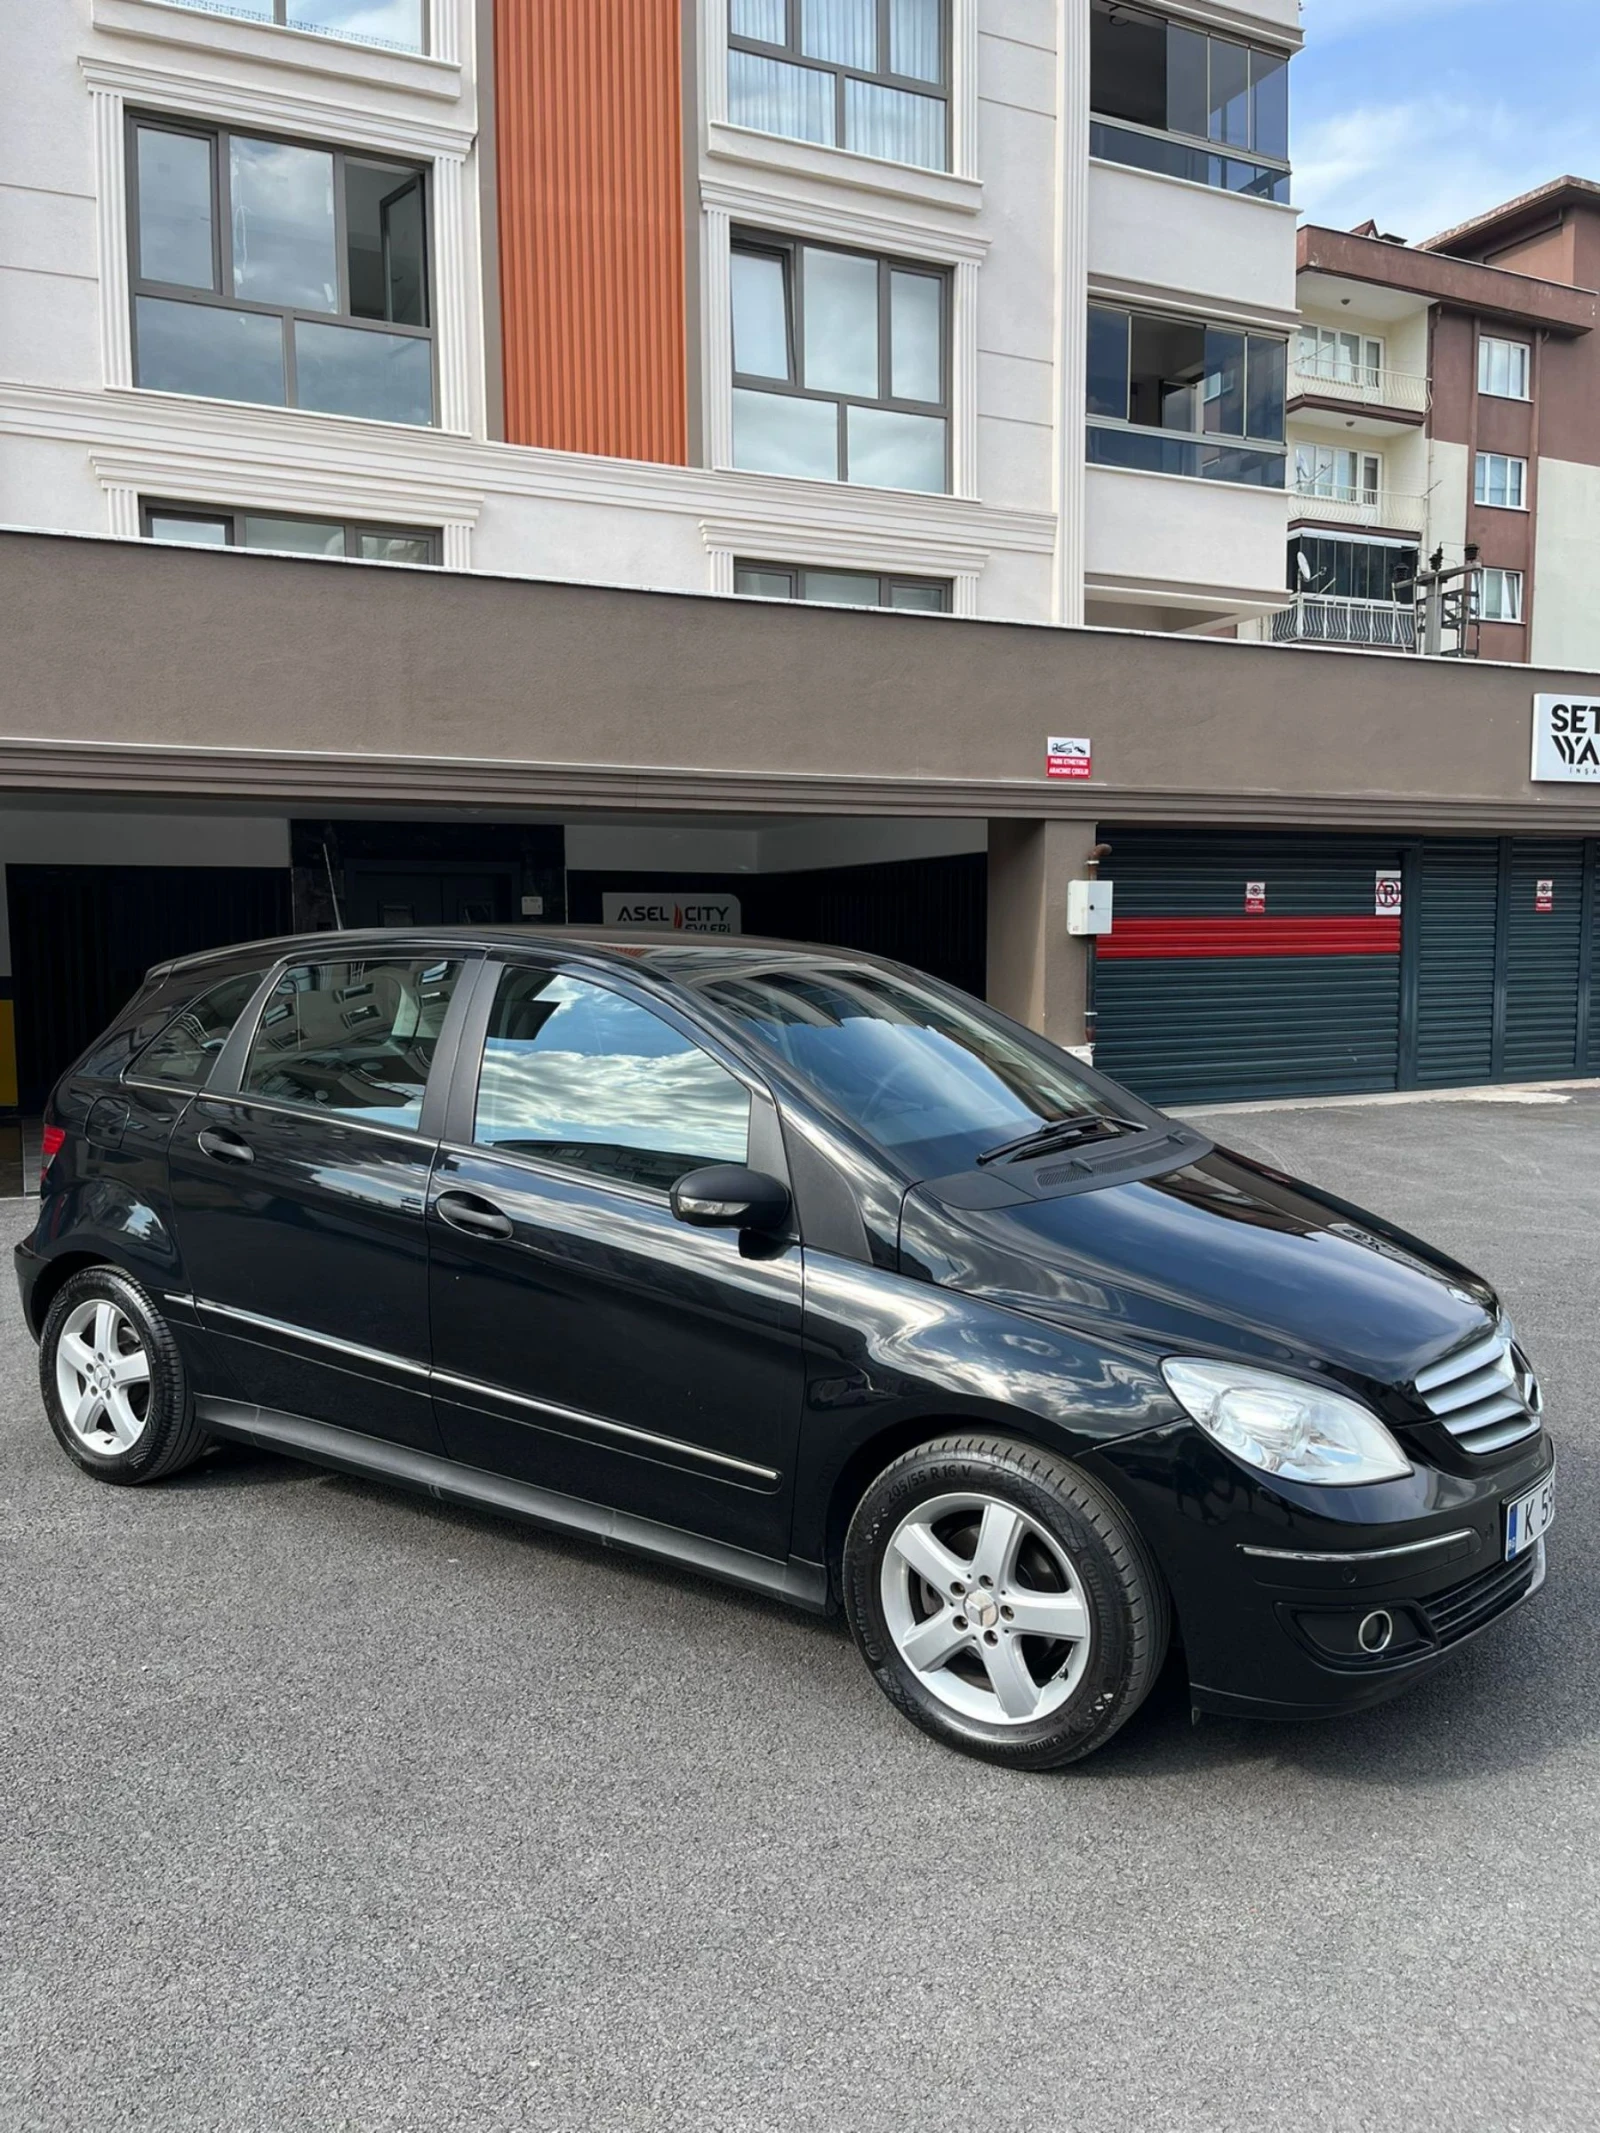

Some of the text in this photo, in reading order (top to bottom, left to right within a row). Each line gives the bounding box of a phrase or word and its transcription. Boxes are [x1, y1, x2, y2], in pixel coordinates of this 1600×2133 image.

[617, 906, 729, 921] ASEL CITY
[887, 1469, 927, 1503] 205/55
[961, 1465, 972, 1477] V
[1525, 1499, 1535, 1540] K
